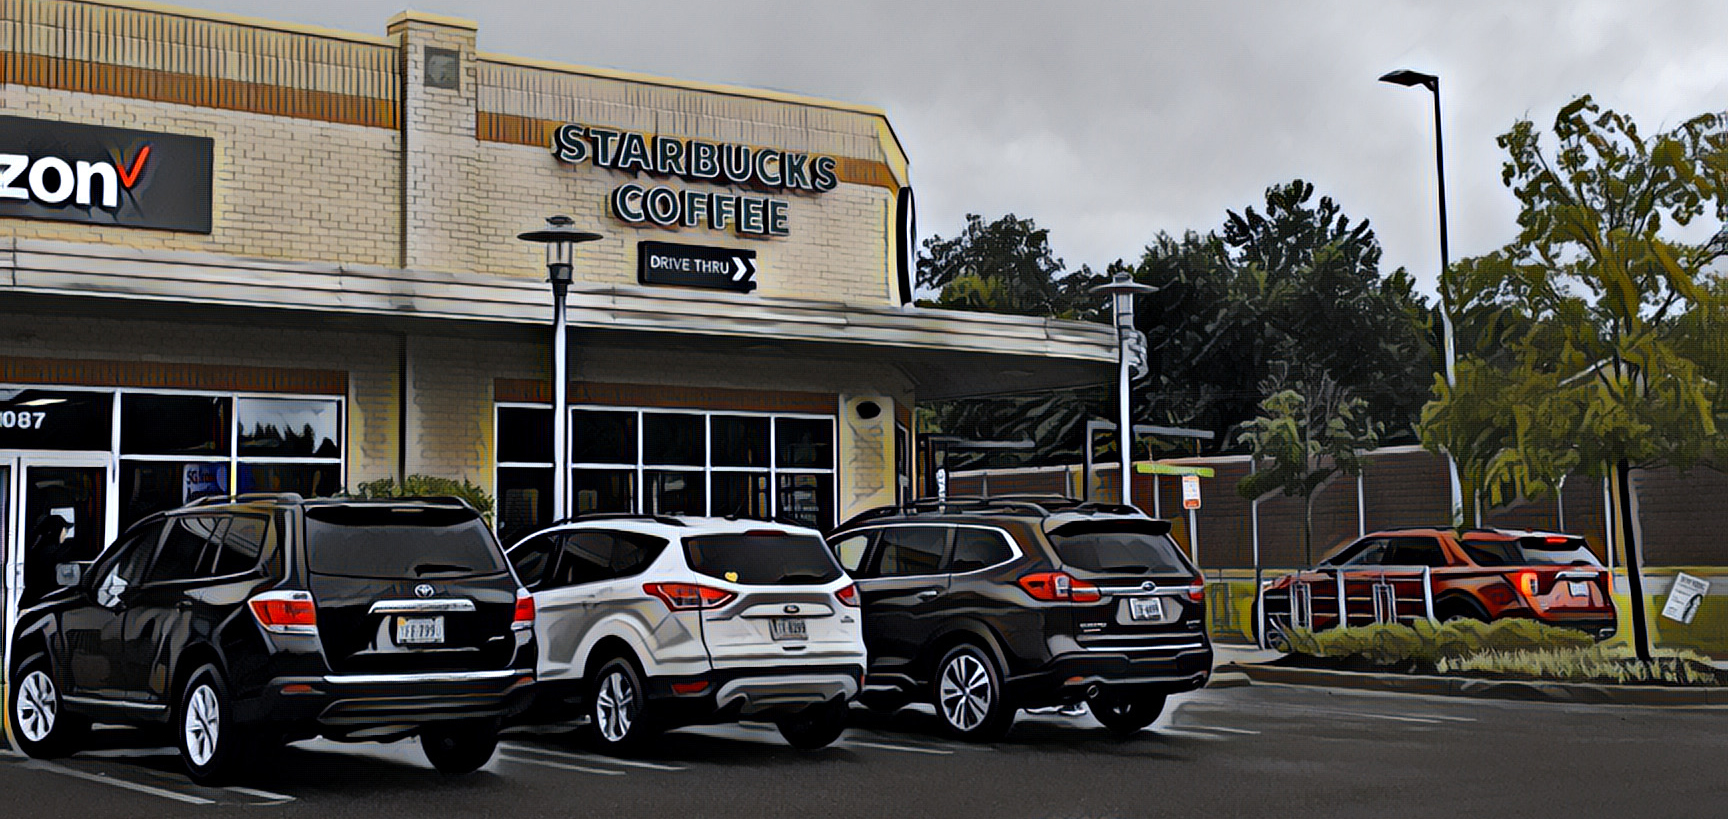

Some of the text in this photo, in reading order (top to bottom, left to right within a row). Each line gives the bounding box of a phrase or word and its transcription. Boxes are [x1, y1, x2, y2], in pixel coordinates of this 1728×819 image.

[557, 123, 839, 193] STARBUCKS
[613, 183, 790, 236] COFFEE
[650, 254, 730, 275] DRIVE THRU
